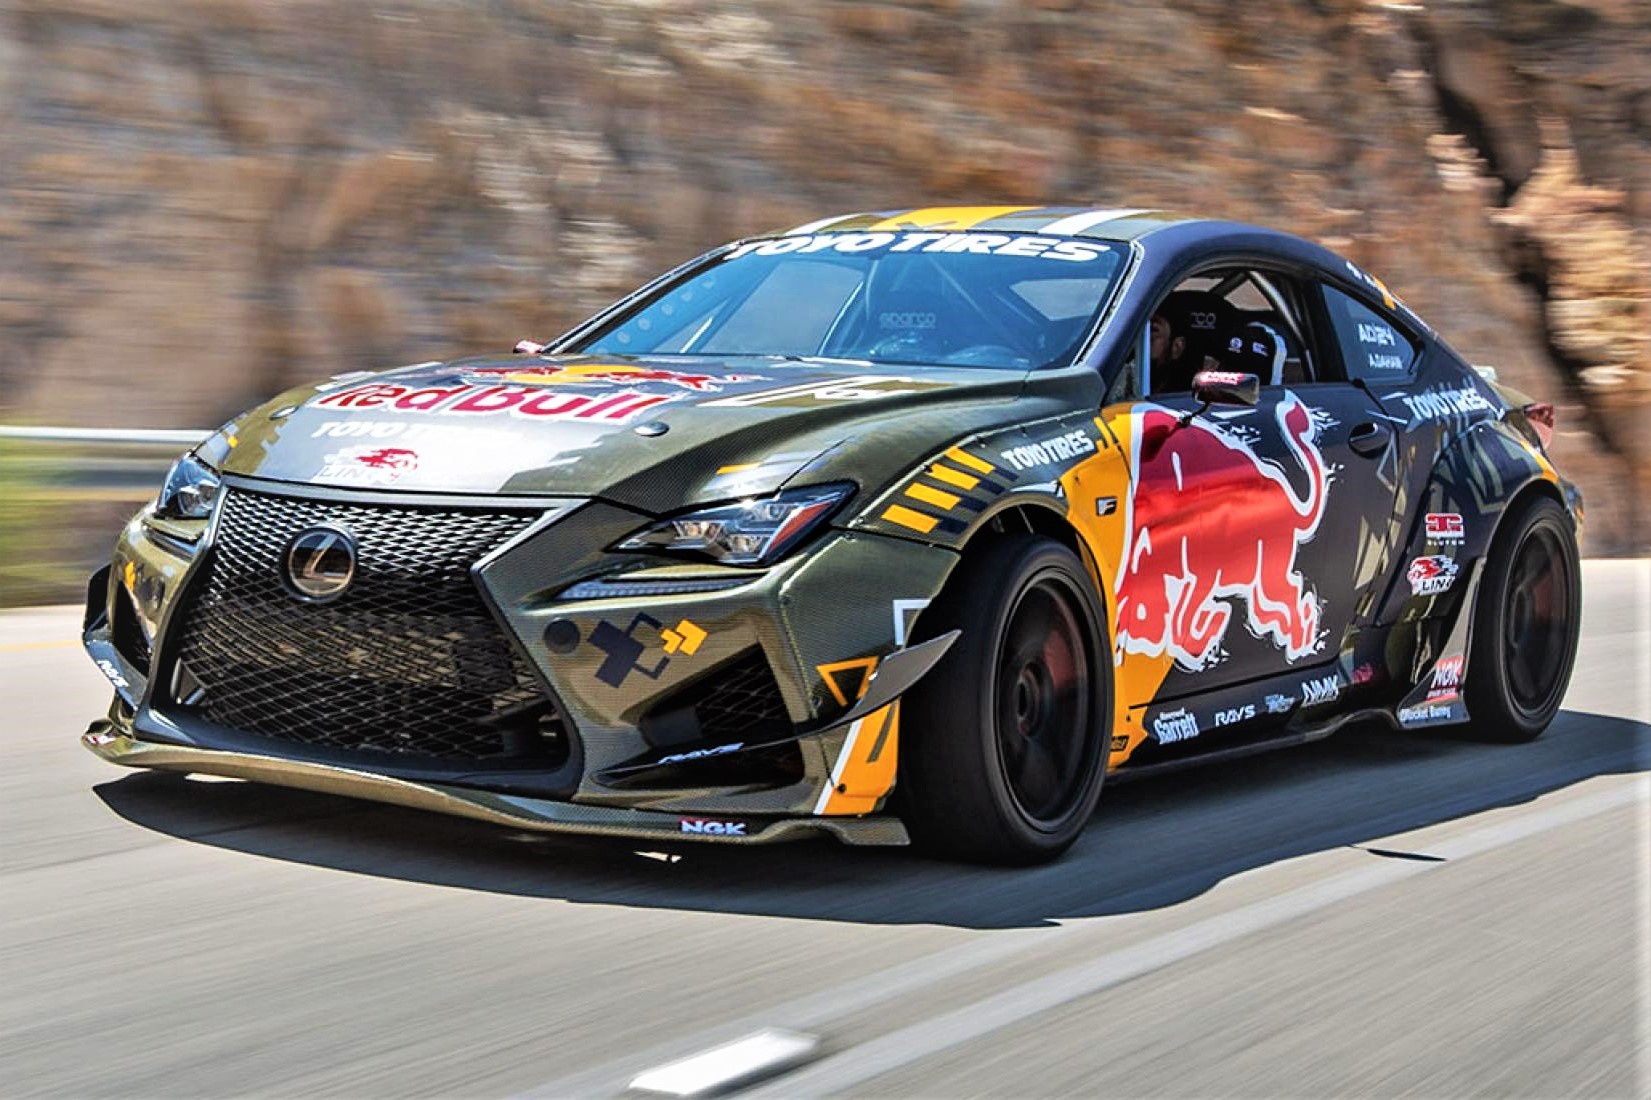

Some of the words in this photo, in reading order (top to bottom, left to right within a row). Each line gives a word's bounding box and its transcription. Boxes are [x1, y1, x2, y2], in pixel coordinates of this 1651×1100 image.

[722, 233, 896, 261] TOYO
[889, 233, 1111, 262] TIRES
[318, 384, 471, 411] Red
[451, 386, 668, 419] Bull
[310, 421, 409, 438] TOYO
[1154, 712, 1199, 745] Garrett
[1215, 704, 1256, 728] RAYS
[680, 819, 747, 836] NGK
